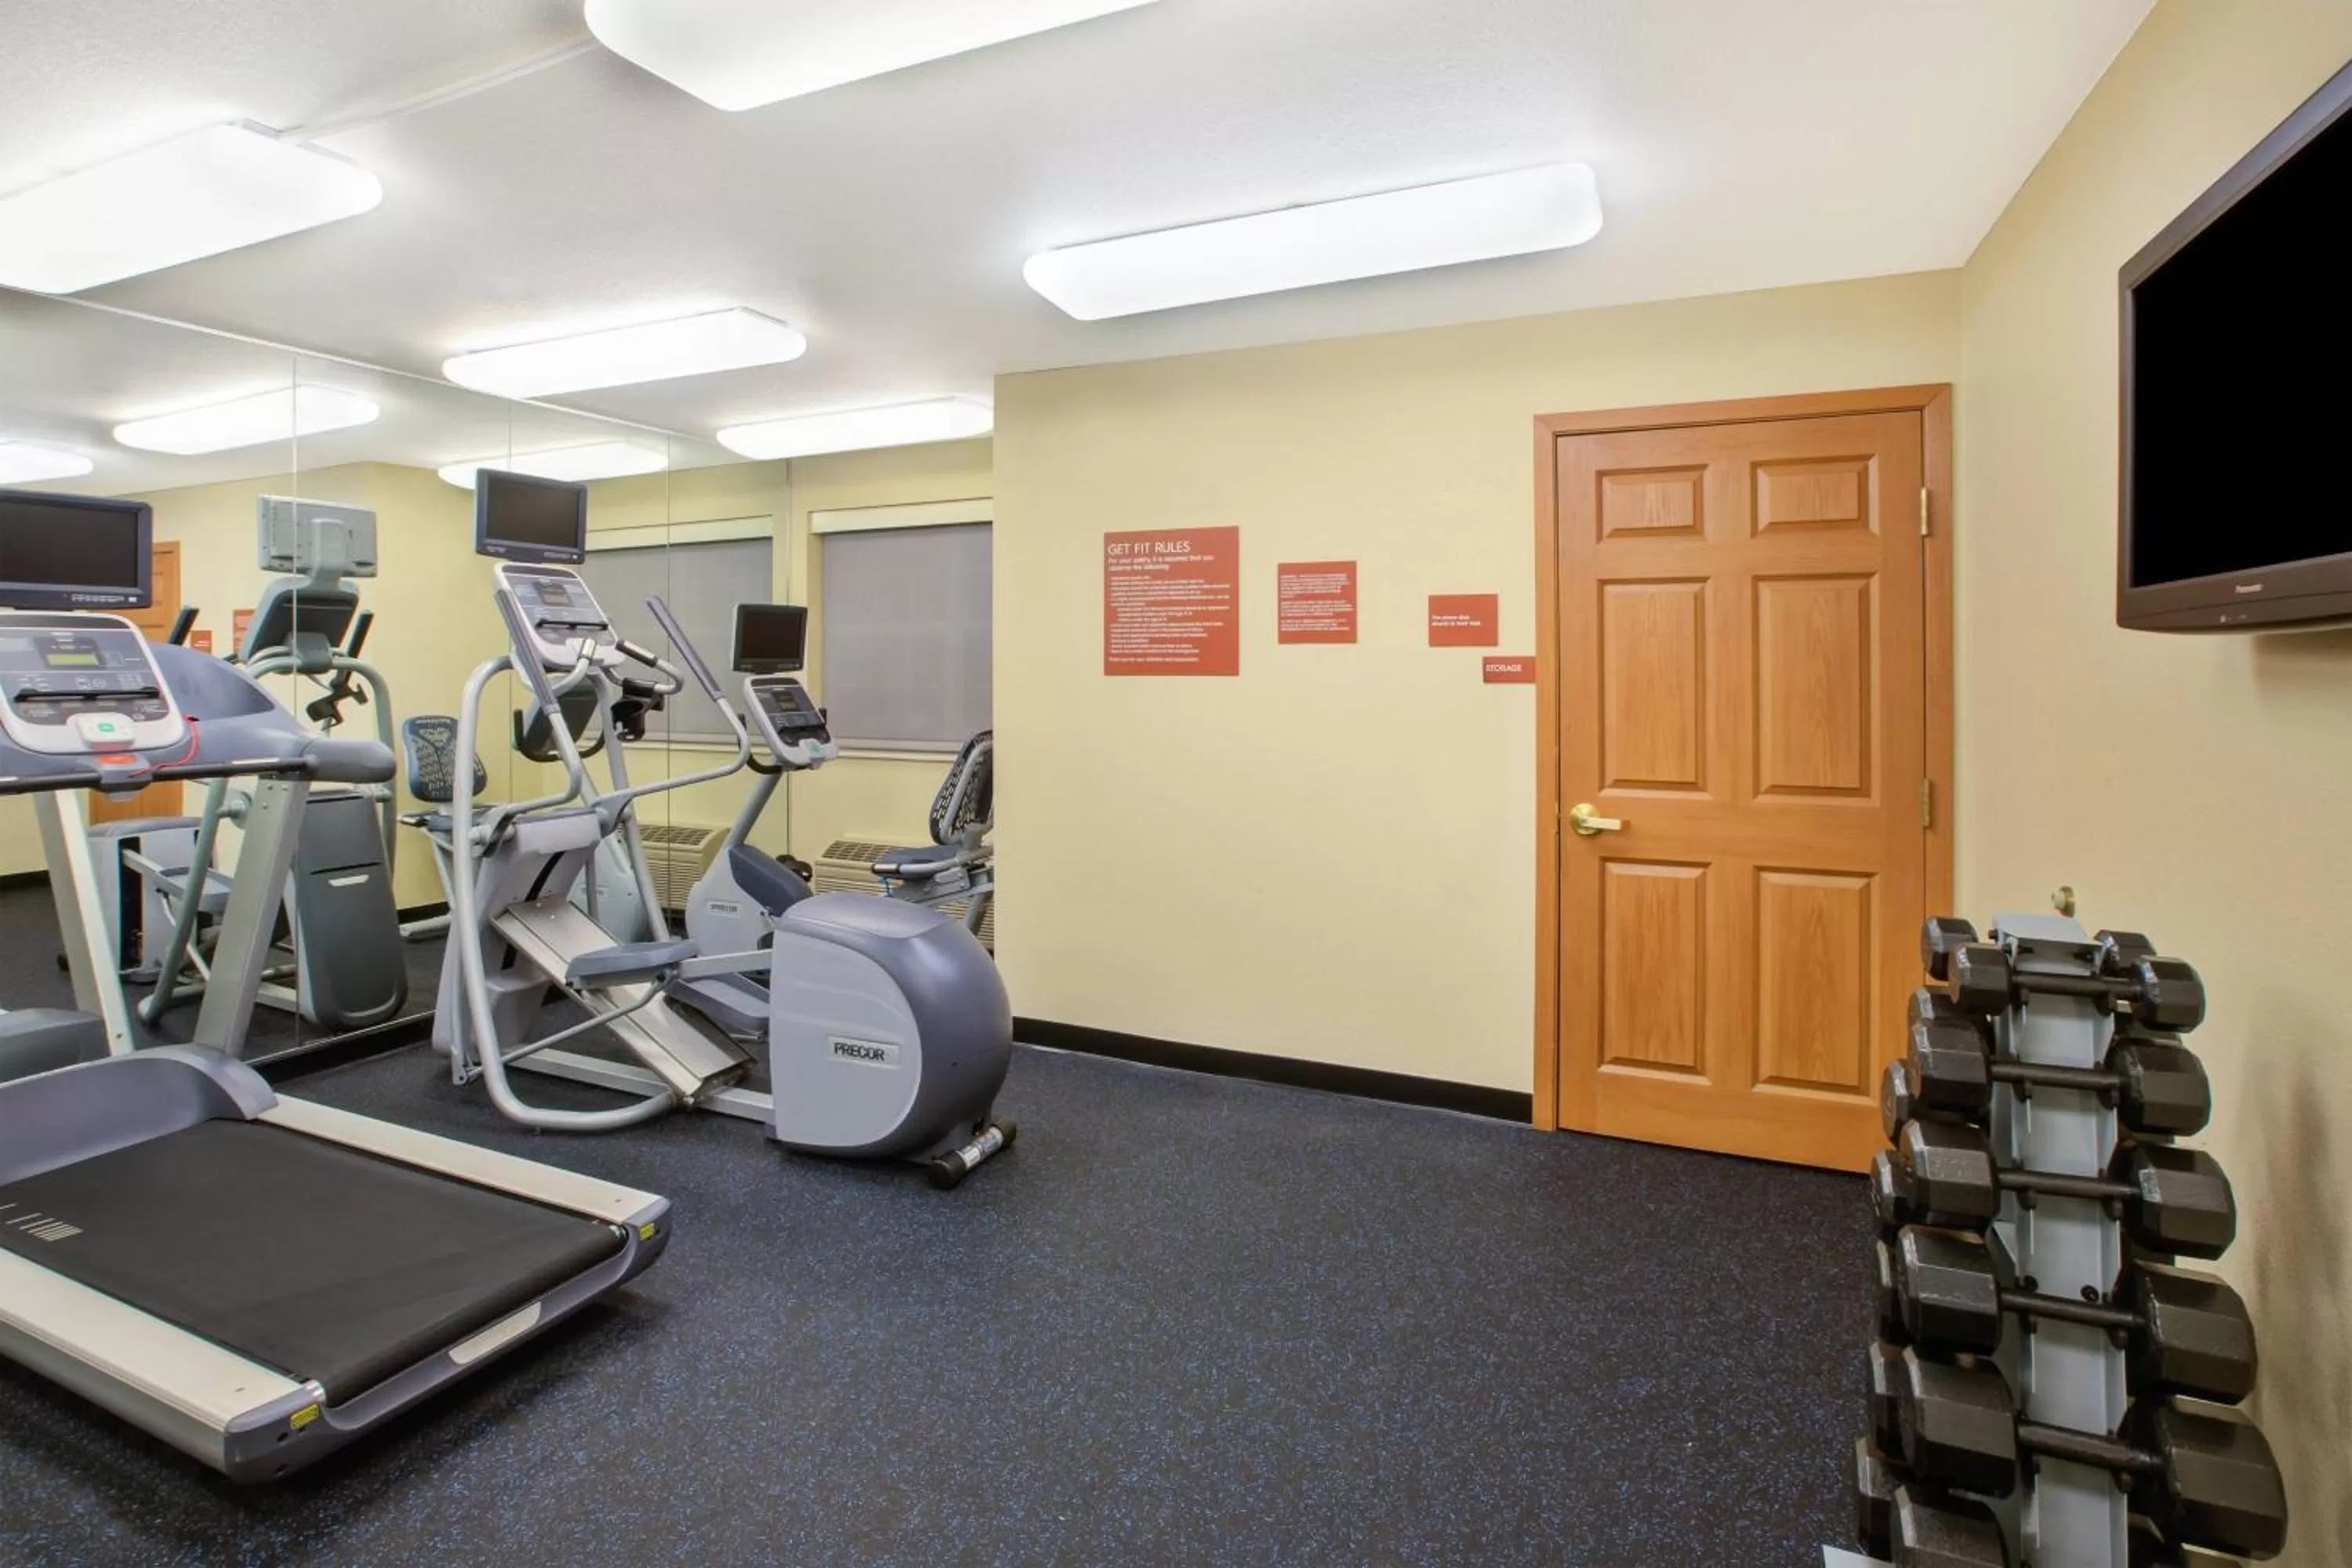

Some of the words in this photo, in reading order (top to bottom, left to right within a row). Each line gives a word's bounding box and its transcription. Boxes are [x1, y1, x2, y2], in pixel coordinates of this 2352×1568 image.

[1108, 543, 1131, 556] GET
[1134, 542, 1150, 554] FIT
[1155, 540, 1191, 553] RULES
[833, 1041, 885, 1062] PRECOR
